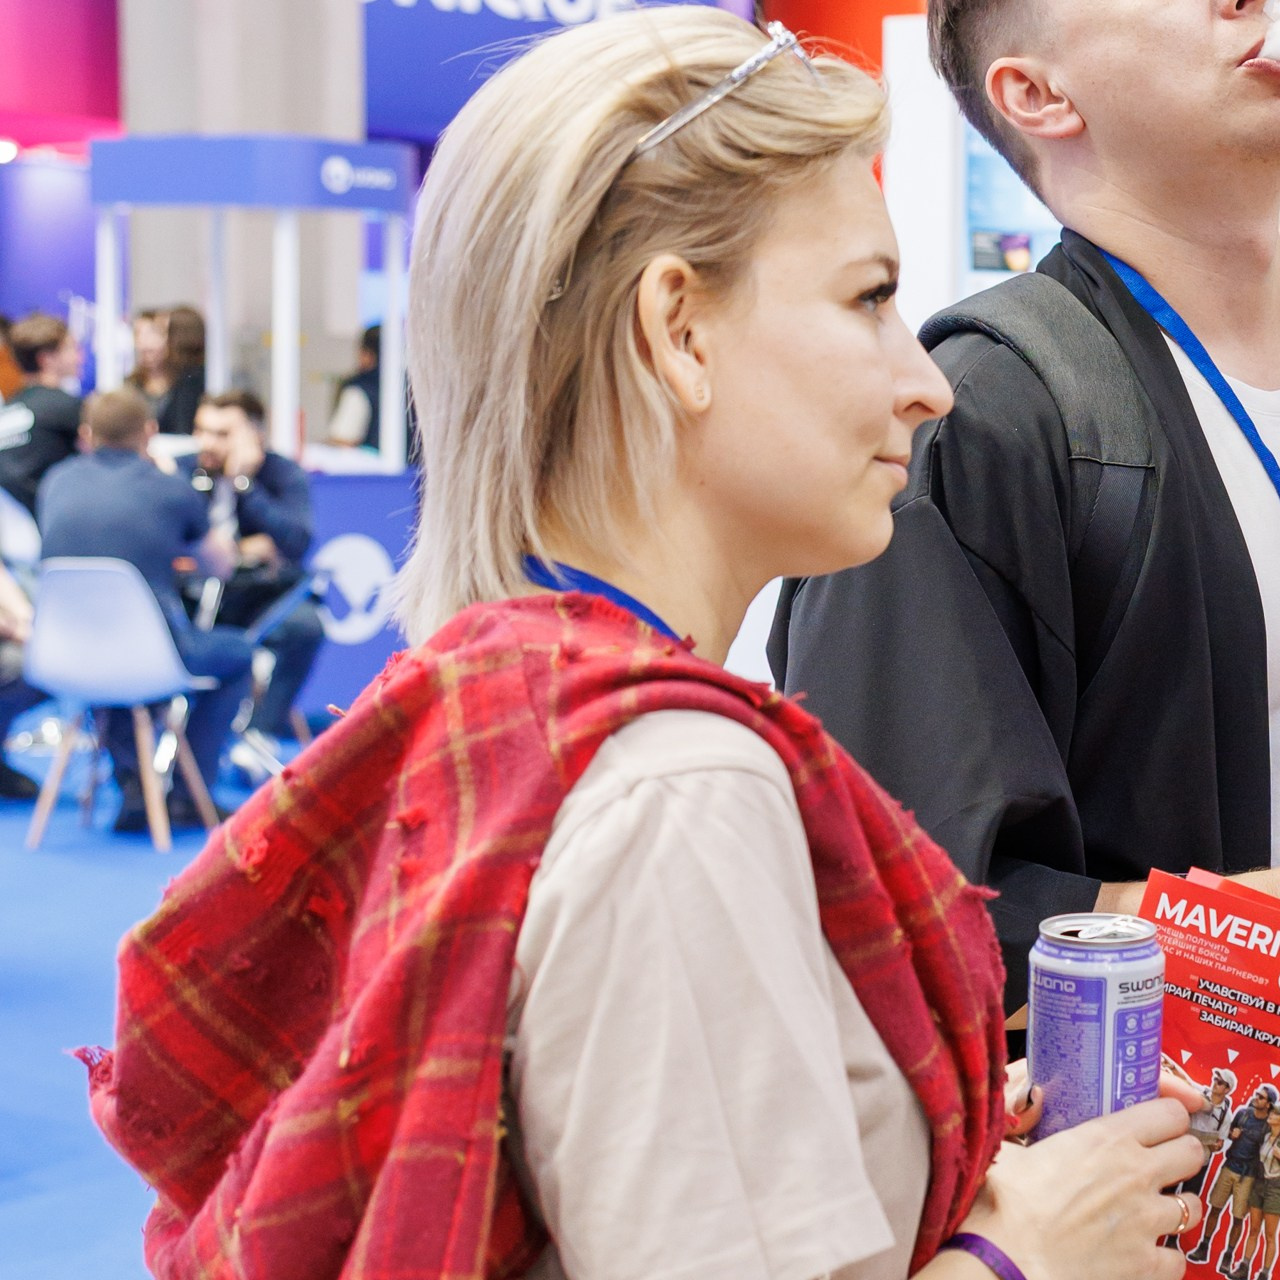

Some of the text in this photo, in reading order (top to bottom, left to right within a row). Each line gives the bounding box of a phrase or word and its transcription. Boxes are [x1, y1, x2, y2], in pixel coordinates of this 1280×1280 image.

[1156, 933, 1197, 953] УТЕЙШИЕ
[1198, 946, 1228, 962] БОКСЫ
[1157, 923, 1230, 954] ОЧЕШЬ ПОЛУЧИТЬ
[1183, 951, 1213, 967] НАШИХ
[1215, 962, 1269, 986] ПАРТНЕРОВ?
[1163, 982, 1191, 1000] ИРАЙ
[1193, 993, 1238, 1016] ПЕЧАТИ
[1199, 979, 1265, 1010] УЧАВСТВУЙ
[1266, 1004, 1276, 1015] В
[1200, 1010, 1254, 1037] ЗАБИРАЙ
